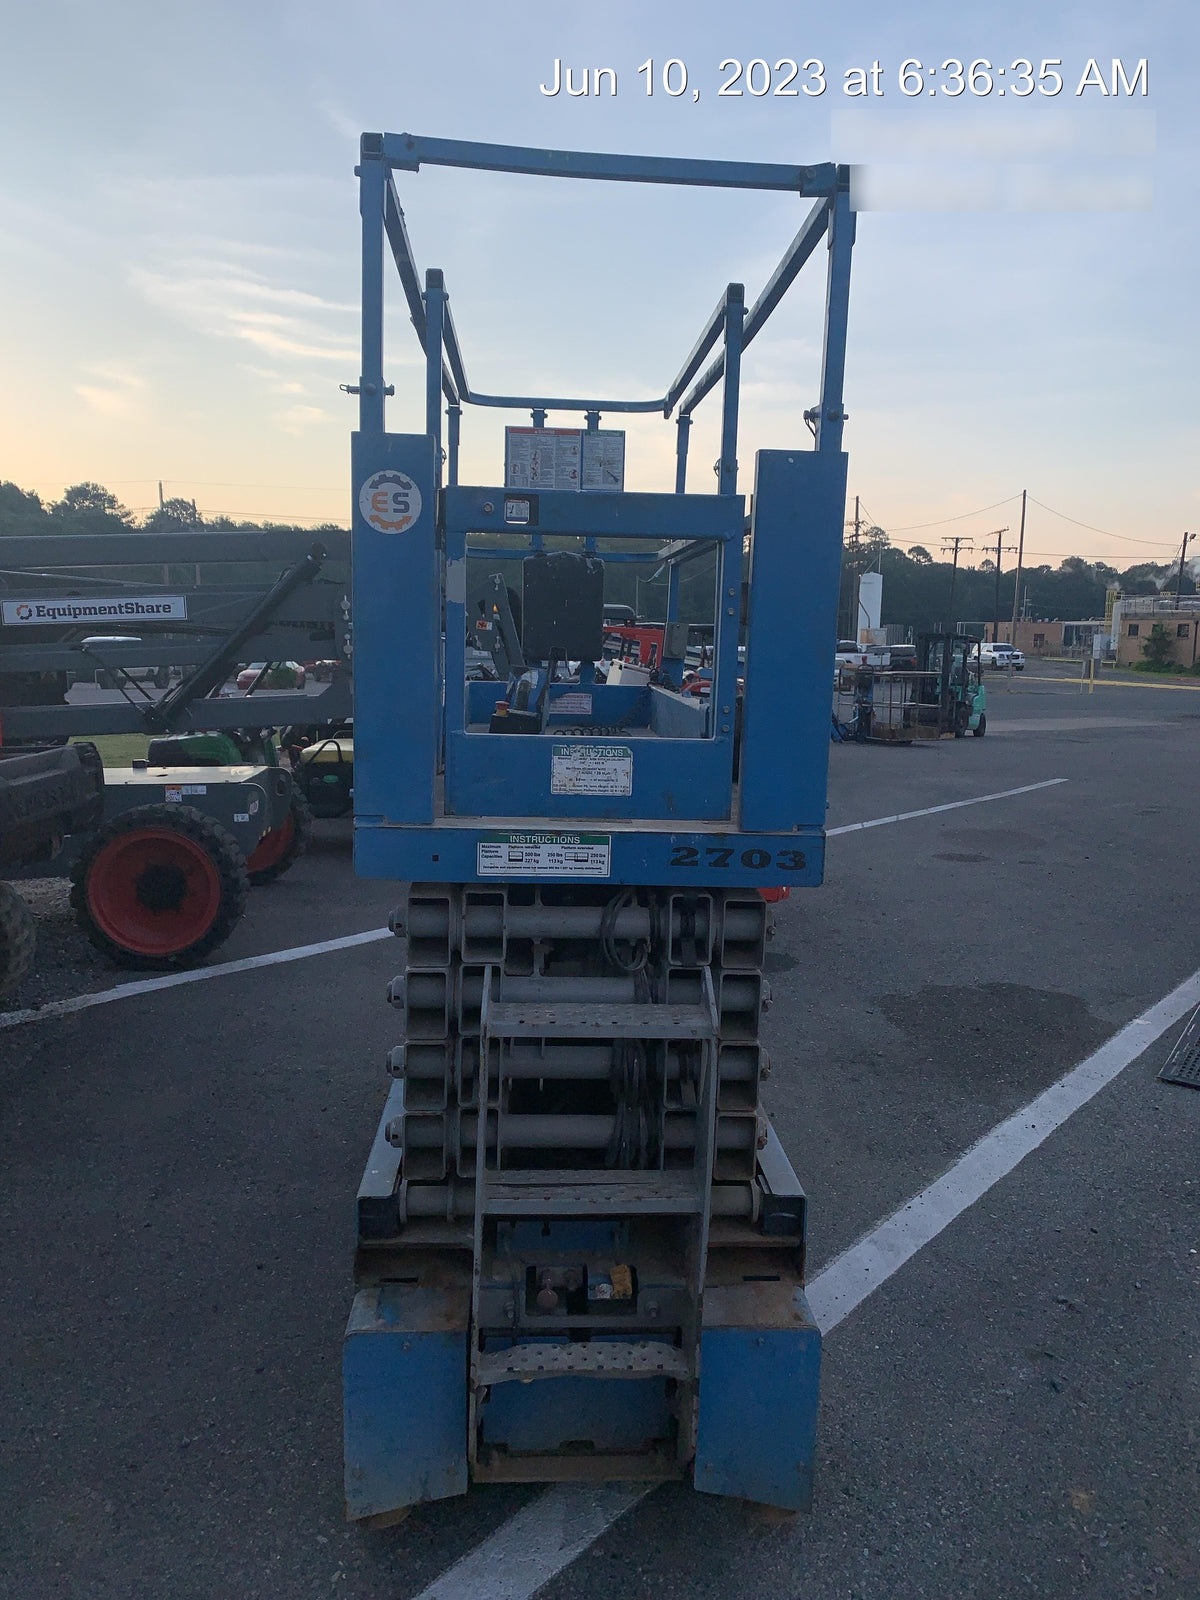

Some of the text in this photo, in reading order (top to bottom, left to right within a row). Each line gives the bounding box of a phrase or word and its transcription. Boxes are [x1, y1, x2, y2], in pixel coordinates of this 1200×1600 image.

[371, 491, 410, 514] ES
[35, 602, 172, 619] EquipmentShare
[561, 747, 624, 757] INSUCTIONS
[510, 835, 580, 844] INSTRUCTIONS
[669, 846, 807, 871] 2703
